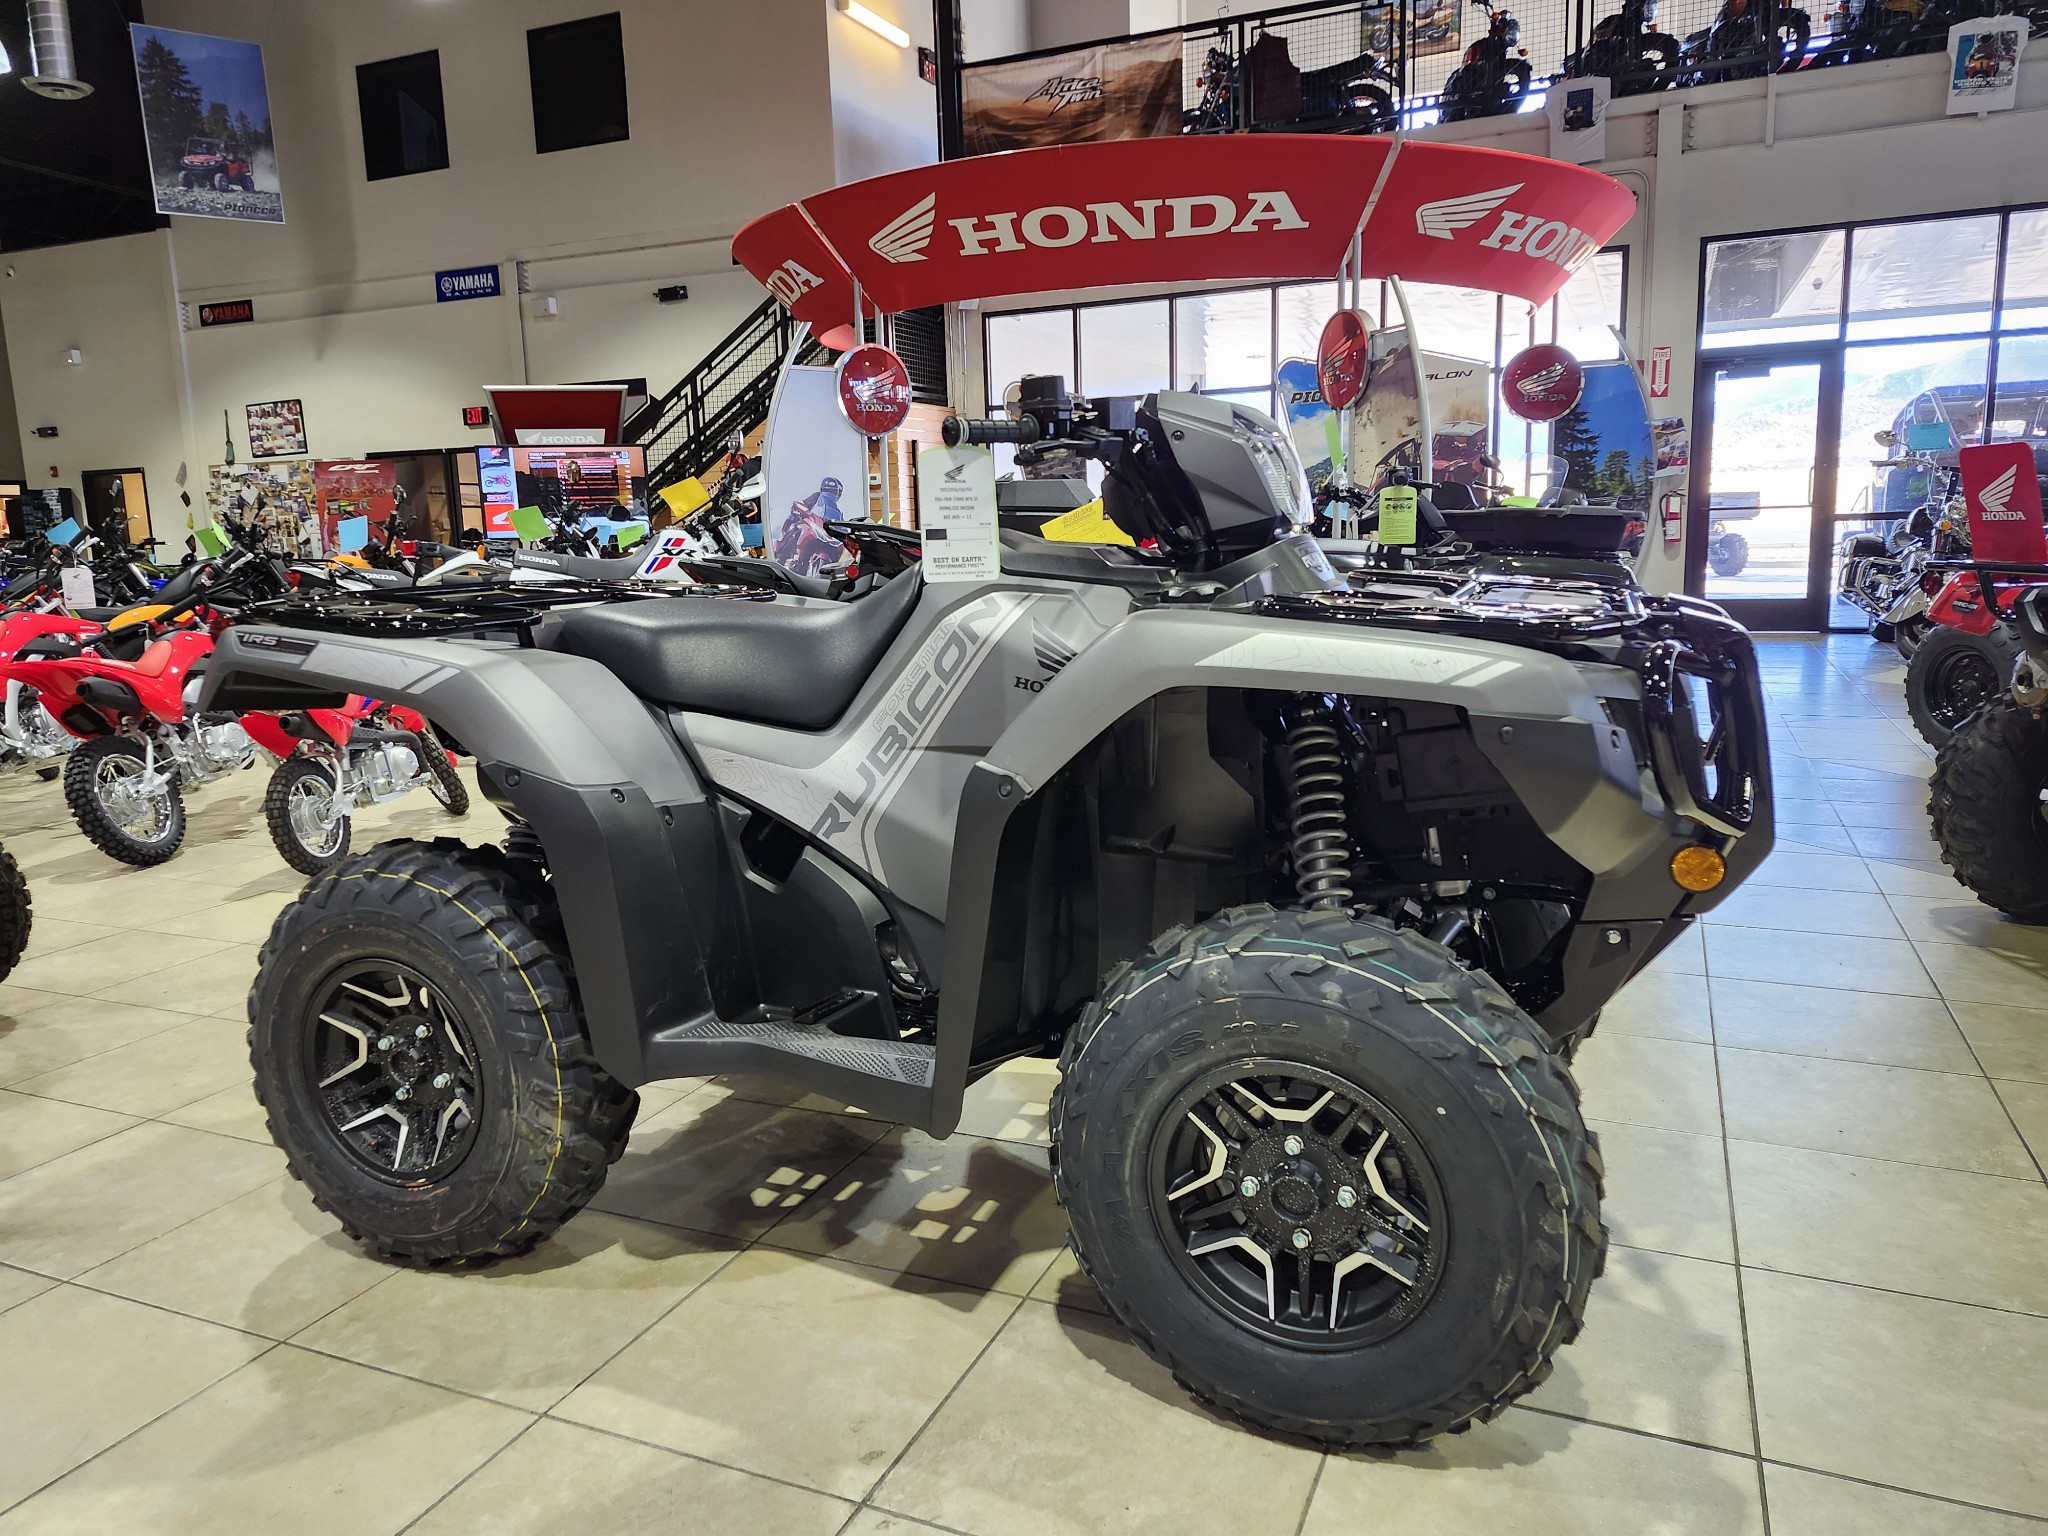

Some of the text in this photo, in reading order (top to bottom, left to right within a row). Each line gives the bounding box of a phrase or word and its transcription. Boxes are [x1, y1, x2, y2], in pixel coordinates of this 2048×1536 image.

[1026, 76, 1107, 101] Africa
[1051, 88, 1105, 114] Twin
[224, 203, 277, 215] PIONEER
[948, 191, 1310, 256] HONDA
[452, 272, 494, 291] YAMAHA
[445, 288, 492, 297] RACING
[213, 303, 250, 321] YAMAHA
[1290, 390, 1324, 405] PIO
[1519, 393, 1567, 403] HONDA
[856, 403, 899, 412] HONDA
[466, 408, 483, 423] EXIT
[541, 435, 597, 443] HONDA
[328, 463, 381, 471] CRF
[1981, 510, 2026, 521] HONDA
[655, 548, 700, 558] XR
[518, 554, 561, 567] HONDA
[242, 633, 280, 646] IRS
[873, 613, 958, 732] FOREMAN
[1013, 675, 1050, 693] HO
[808, 602, 1003, 840] RUBICON
